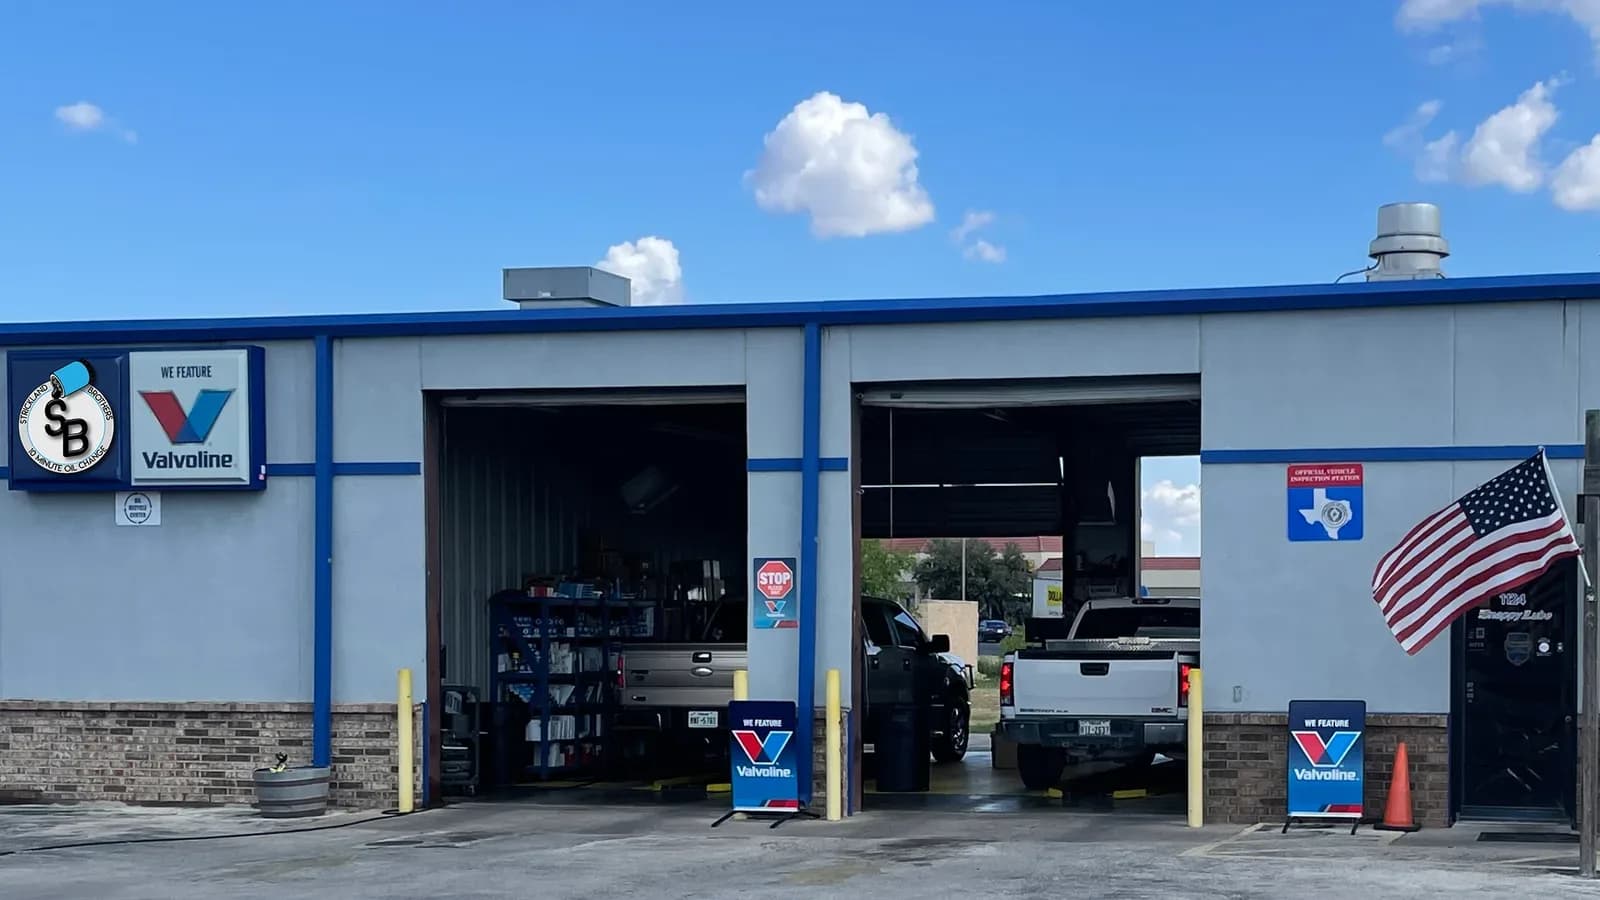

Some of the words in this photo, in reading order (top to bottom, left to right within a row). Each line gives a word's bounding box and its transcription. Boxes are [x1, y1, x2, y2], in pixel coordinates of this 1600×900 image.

[161, 366, 174, 378] WE
[176, 365, 212, 378] FEATURE
[20, 384, 48, 424] STRICKLAND
[87, 386, 113, 421] BROTHERS
[28, 447, 36, 457] 10
[36, 455, 62, 472] MINUTE
[64, 464, 77, 472] OIL
[78, 445, 107, 469] CHANGE
[142, 450, 233, 469] Valvoline
[1294, 468, 1326, 476] OFFICIAL
[1327, 467, 1356, 475] VEHICLE
[760, 572, 790, 585] STOP
[1499, 593, 1526, 606] 1124
[1477, 609, 1522, 621] Snappy
[1521, 609, 1553, 620] Lube
[743, 719, 753, 727] WE
[754, 719, 782, 727] FEATURE
[1304, 719, 1316, 727] WE
[1318, 719, 1349, 727] FEATURE
[736, 766, 791, 778] Valvoline
[1294, 768, 1357, 781] Valvoline
